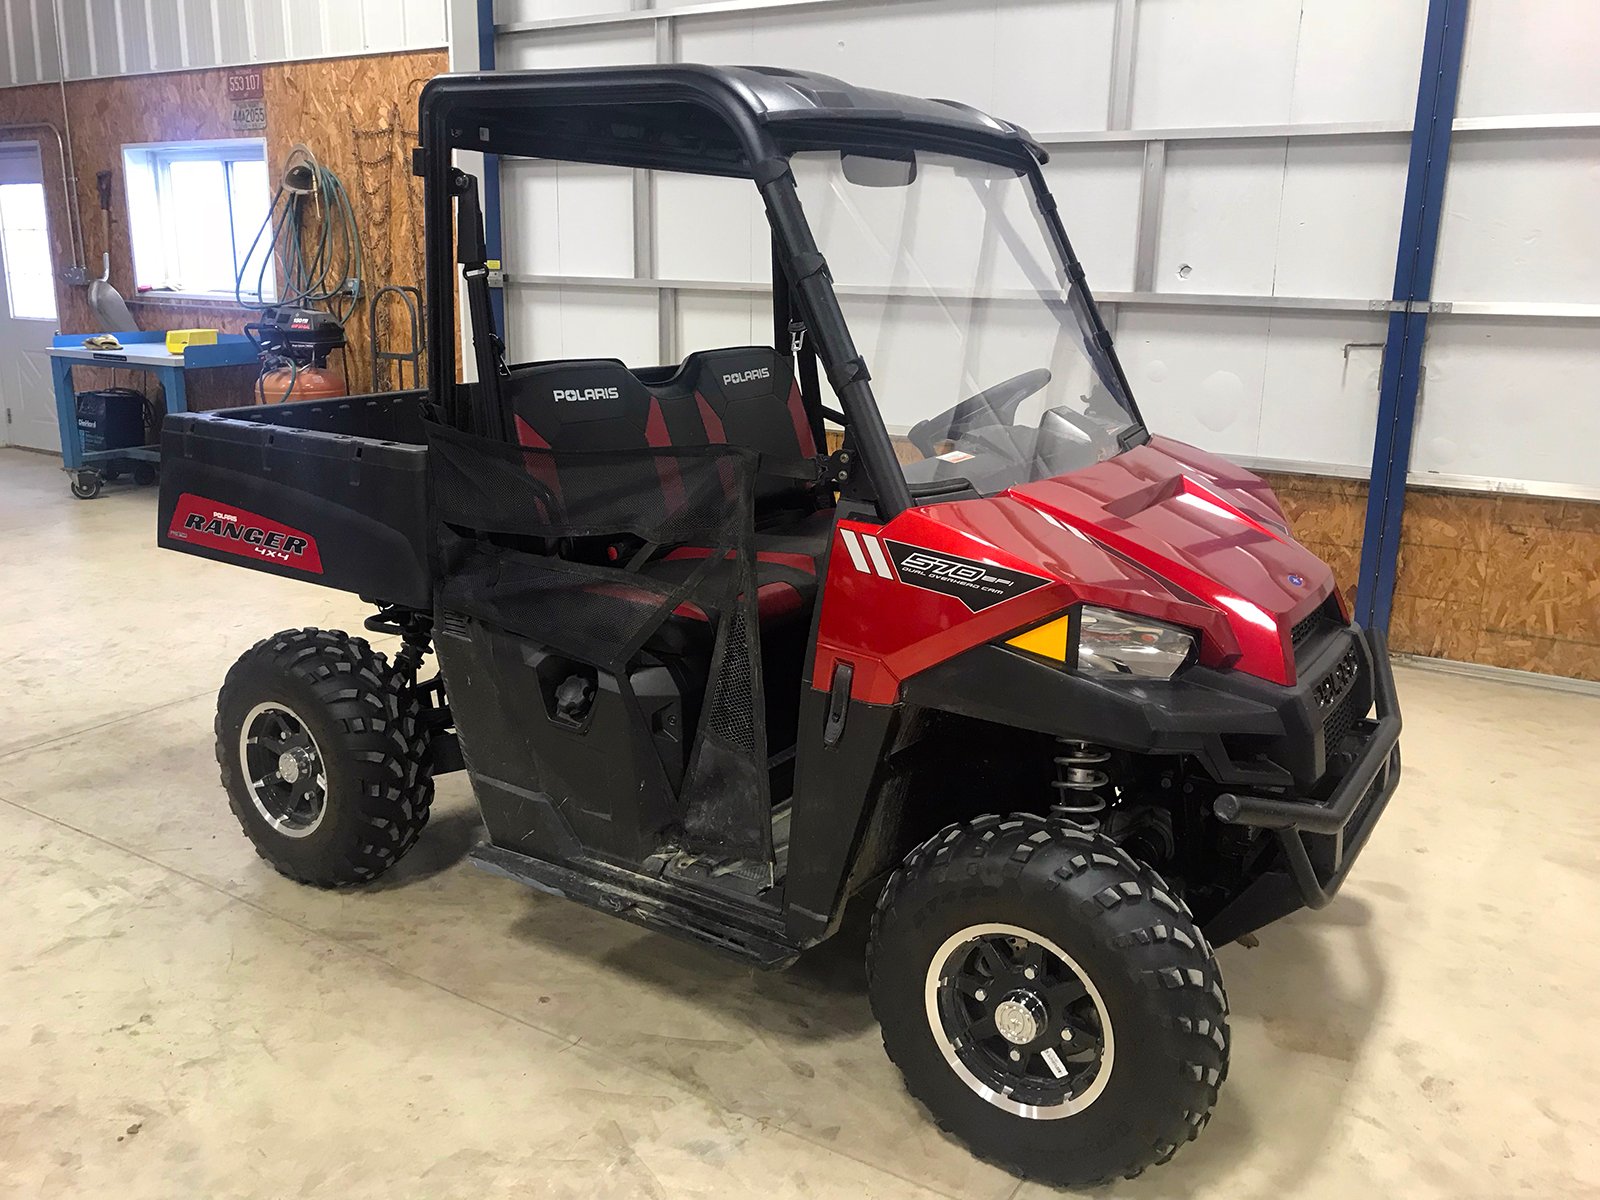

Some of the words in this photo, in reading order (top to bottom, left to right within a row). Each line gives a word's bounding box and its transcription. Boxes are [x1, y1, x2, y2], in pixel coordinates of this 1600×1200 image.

[723, 367, 770, 386] POLARIS
[553, 387, 619, 403] POLARIS
[213, 512, 237, 522] POLARIS
[185, 513, 307, 555] RANGER
[901, 553, 986, 582] 570
[902, 567, 926, 576] DUAL
[929, 574, 980, 589] OVERHEAD
[981, 586, 1003, 594] CAM
